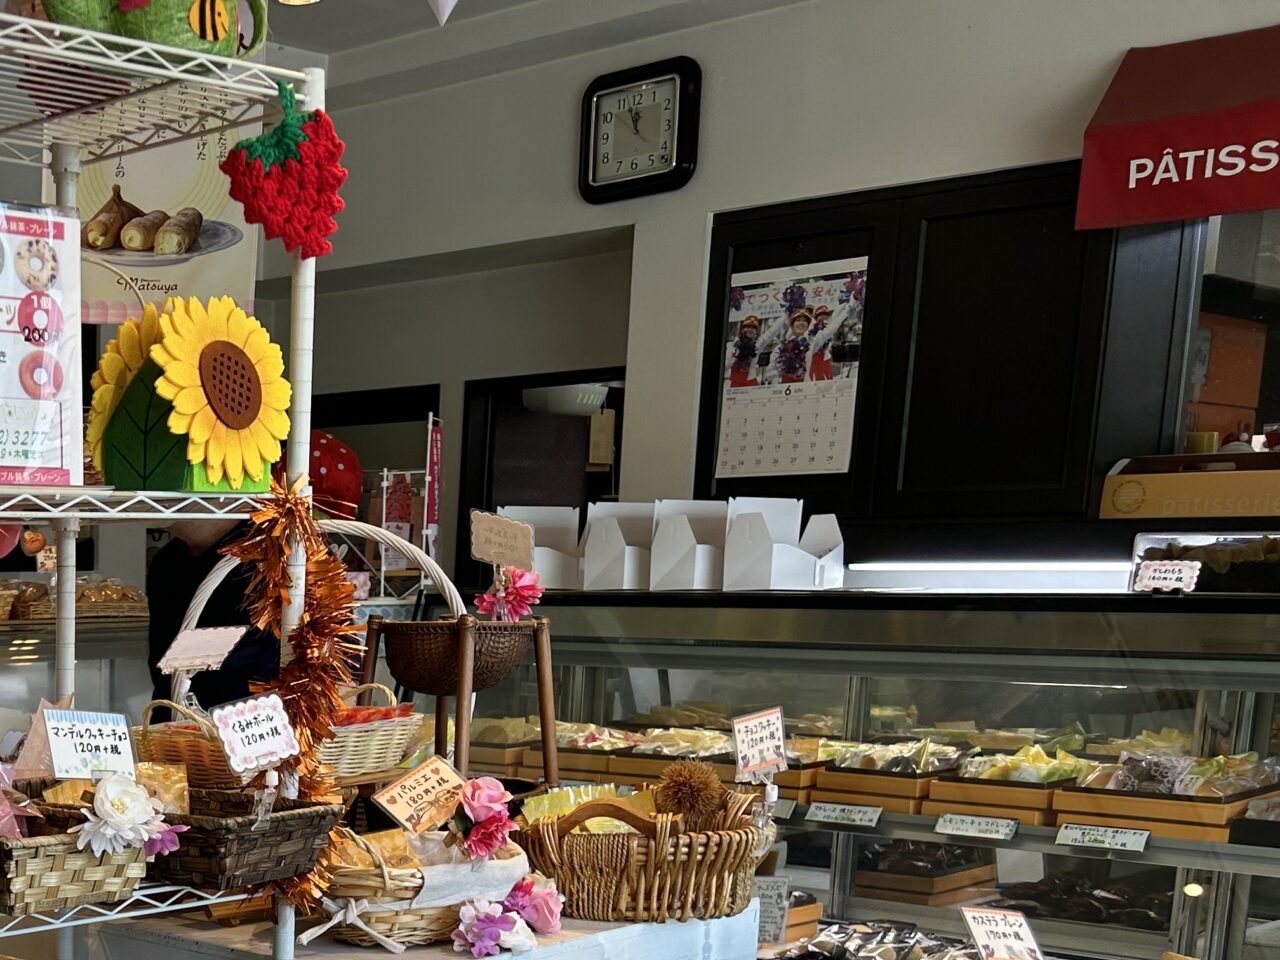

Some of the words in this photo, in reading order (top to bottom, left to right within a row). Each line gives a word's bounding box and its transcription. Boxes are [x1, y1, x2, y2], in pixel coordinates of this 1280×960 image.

[632, 93, 643, 106] 12
[652, 91, 656, 102] 1
[618, 98, 626, 110] 11
[664, 98, 671, 110] 2
[602, 111, 613, 124] 10
[664, 120, 671, 131] 3
[602, 132, 609, 144] 9
[661, 140, 668, 152] 4
[602, 153, 609, 164] 8
[631, 158, 638, 170] 6
[648, 154, 654, 166] 5
[1128, 139, 1280, 189] PÂTISS
[616, 161, 622, 173] 7
[784, 385, 792, 396] 6
[231, 713, 274, 733] くるみボール
[743, 719, 776, 738] チョコクッキー
[51, 724, 128, 742] マンデルクッキーチョコ
[396, 773, 432, 799] パルミエ
[971, 915, 999, 927] カステラ
[1000, 913, 1023, 928] プレーン
